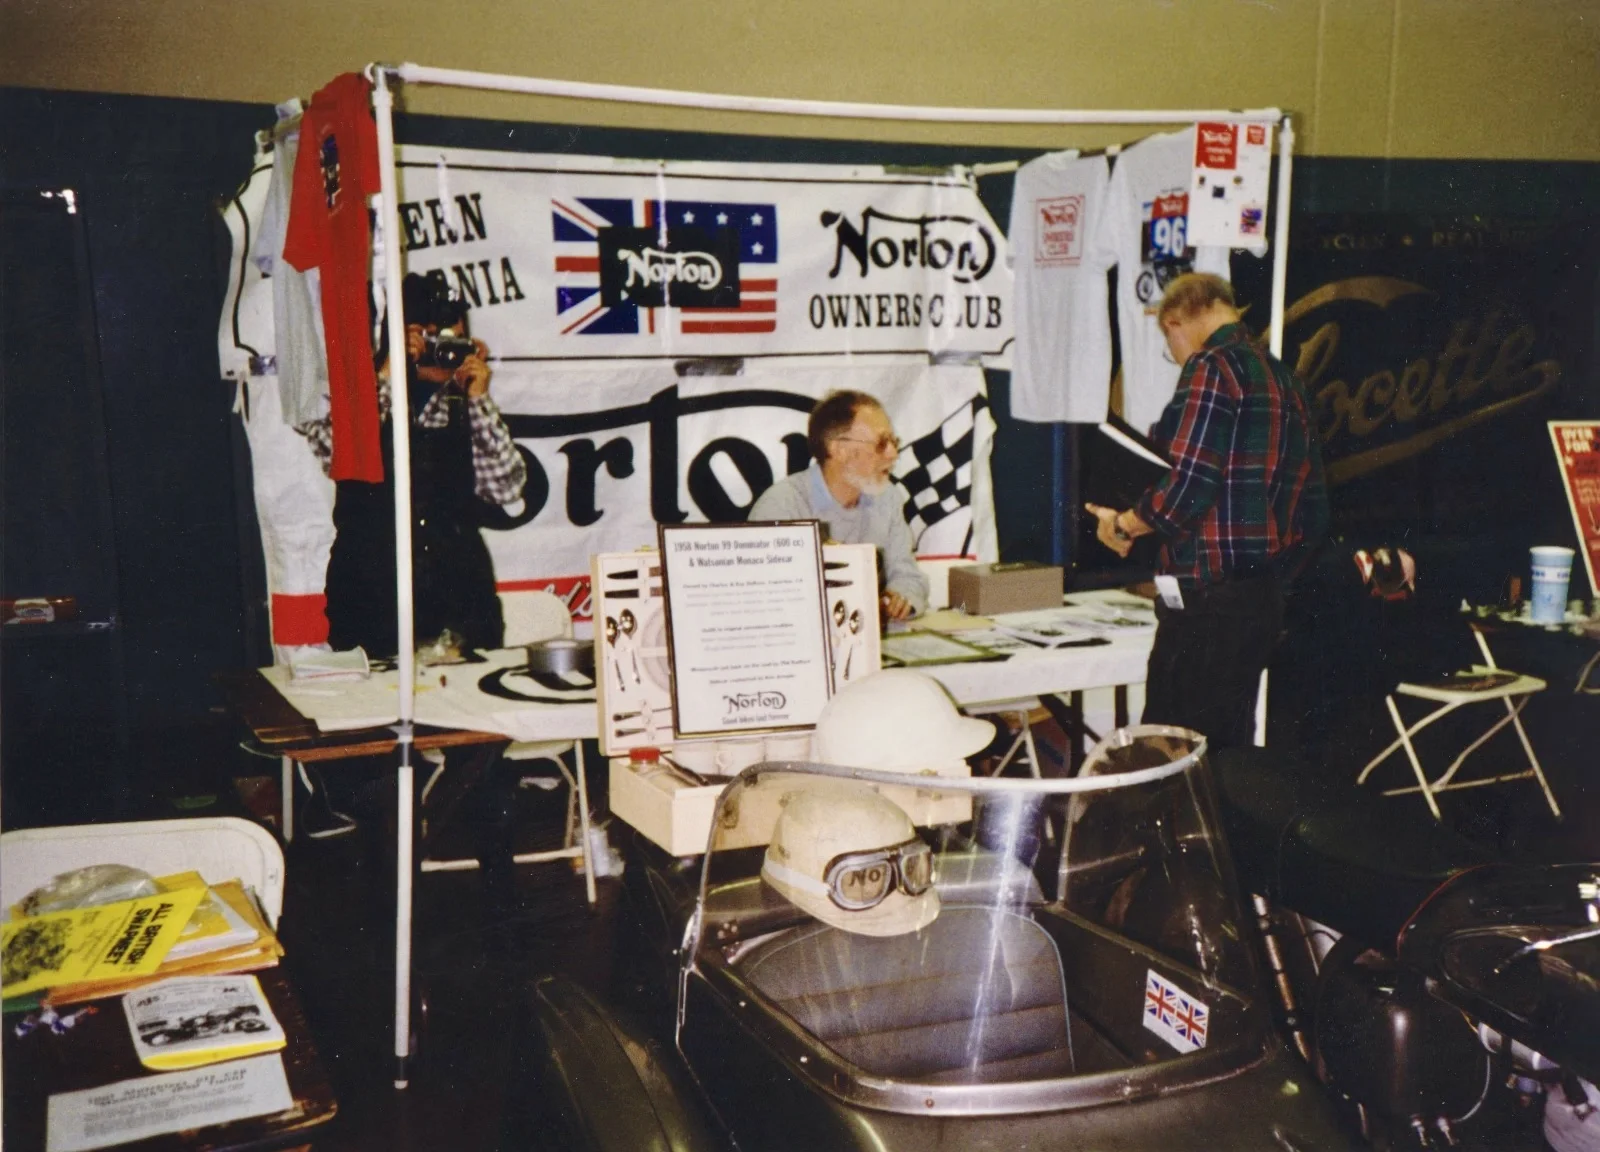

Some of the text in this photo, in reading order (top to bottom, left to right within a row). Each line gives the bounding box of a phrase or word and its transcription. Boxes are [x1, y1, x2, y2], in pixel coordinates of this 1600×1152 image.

[819, 206, 996, 283] Norton
[1154, 216, 1185, 258] 96
[617, 246, 723, 291] Norton
[809, 293, 1002, 330] OWNERS CUB
[477, 384, 816, 531] orto
[694, 540, 719, 551] Norton
[722, 690, 786, 714] Norton
[151, 903, 174, 922] ALL
[123, 924, 163, 966] BRITISH
